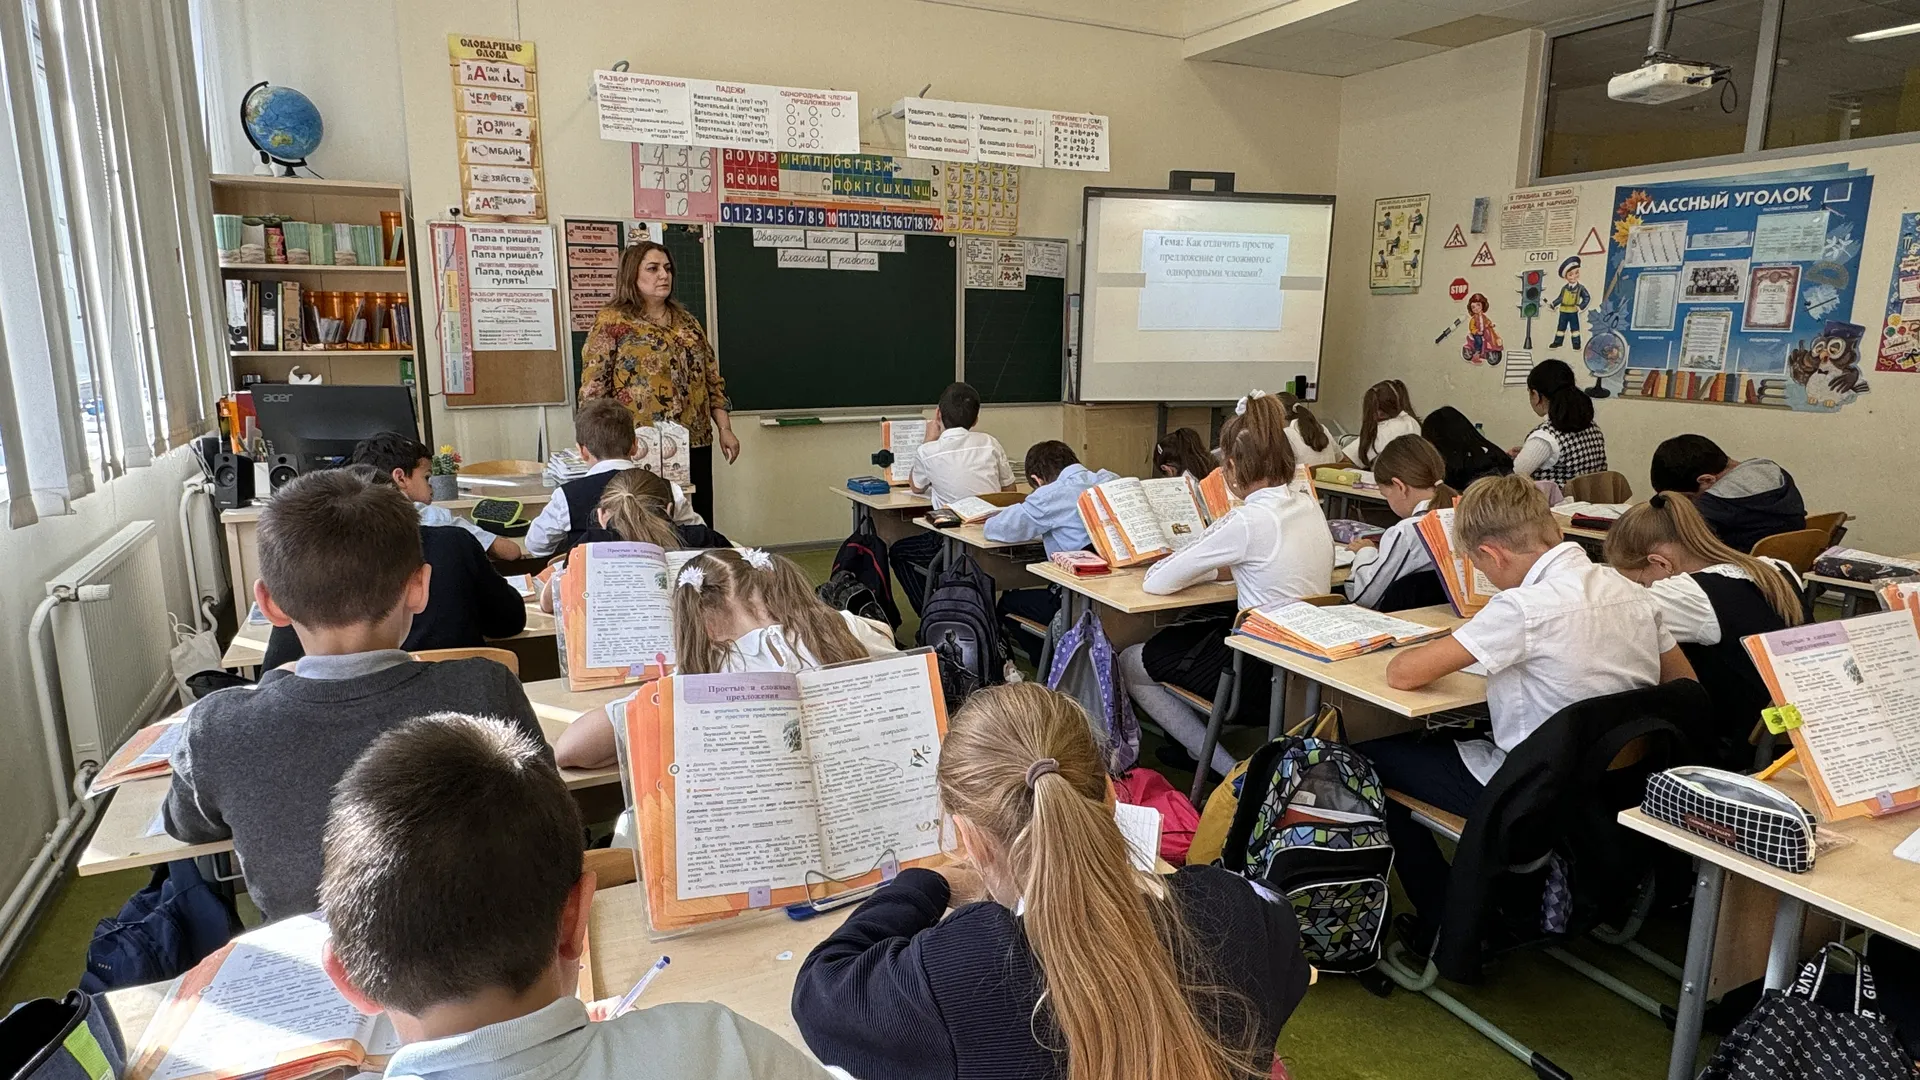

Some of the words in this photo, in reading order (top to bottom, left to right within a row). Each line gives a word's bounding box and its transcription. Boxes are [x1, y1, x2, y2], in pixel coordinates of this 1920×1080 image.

[460, 38, 522, 52] СЛОВАРНЫЕ
[476, 49, 508, 59] СЛОВА
[599, 74, 628, 83] РАЗБОР
[630, 78, 686, 88] ПРЕДЛОЖЕНИЯ
[716, 84, 746, 94] ПАДЕЖИ
[780, 90, 826, 100] ОДНОРОДНЫЕ
[792, 98, 840, 106] ПРЕДЛОЖЕНИЯ
[472, 144, 522, 156] КОМБАЙН
[654, 146, 664, 164] 4
[677, 148, 688, 166] 5
[700, 150, 711, 168] 6
[654, 171, 664, 189] 7
[677, 173, 688, 192] 8
[701, 175, 711, 192] 9
[726, 174, 734, 184] я
[738, 170, 744, 185] ё
[748, 174, 757, 185] ю
[760, 174, 768, 186] и
[770, 175, 778, 186] е
[834, 180, 842, 191] п
[844, 178, 852, 194] ф
[854, 182, 860, 192] к
[865, 182, 871, 192] т
[875, 182, 880, 192] с
[884, 182, 892, 193] ш
[893, 184, 900, 194] х
[903, 184, 911, 196] ц
[914, 184, 920, 195] ч
[922, 185, 930, 197] щ
[932, 188, 938, 198] ь
[678, 198, 688, 216] 0
[1547, 198, 1577, 206] НАРУШАЮ
[1636, 190, 1729, 215] КЛАССНЫЙ
[1734, 186, 1814, 208] УГОЛОК
[723, 207, 730, 220] 0
[735, 208, 739, 220] 1
[745, 208, 751, 221] 2
[756, 209, 762, 221] 3
[766, 209, 773, 221] 4
[777, 210, 783, 222] 5
[788, 210, 794, 222] 6
[798, 211, 804, 222] 7
[808, 211, 814, 223] 8
[818, 212, 824, 223] 9
[828, 212, 836, 224] 10
[839, 212, 848, 224] 11
[850, 213, 859, 225] 12
[861, 214, 870, 226] 13
[872, 214, 881, 226] 14
[883, 214, 891, 227] 15
[893, 215, 902, 228] 16
[904, 215, 912, 228] 17
[915, 216, 923, 229] 18
[925, 216, 933, 230] 19
[934, 217, 943, 230] 20
[472, 234, 496, 242] Папа
[500, 235, 541, 244] пришёл.
[754, 230, 804, 243] Двадцать
[813, 236, 849, 245] шестое
[860, 235, 903, 250] сентября
[1159, 236, 1184, 247] Тема:
[1186, 238, 1201, 248] Как
[1204, 239, 1240, 249] отличить
[1242, 240, 1274, 251] простое
[472, 250, 496, 258] Папа
[500, 251, 544, 260] пришёл?
[779, 252, 826, 264] Классная
[838, 254, 876, 267] работа
[1160, 252, 1214, 264] предложение
[1216, 255, 1224, 263] от
[1226, 256, 1264, 264] сложного
[1530, 252, 1554, 260] СТОП
[475, 267, 503, 276] Папа,
[506, 267, 544, 277] пойдём
[1166, 268, 1222, 279] однородными
[1224, 269, 1262, 278] членами?
[492, 277, 528, 286] гулять!
[1450, 284, 1468, 294] STOP
[262, 392, 293, 402] acer
[708, 684, 745, 694] Простые
[1795, 962, 1818, 996] GLVR
